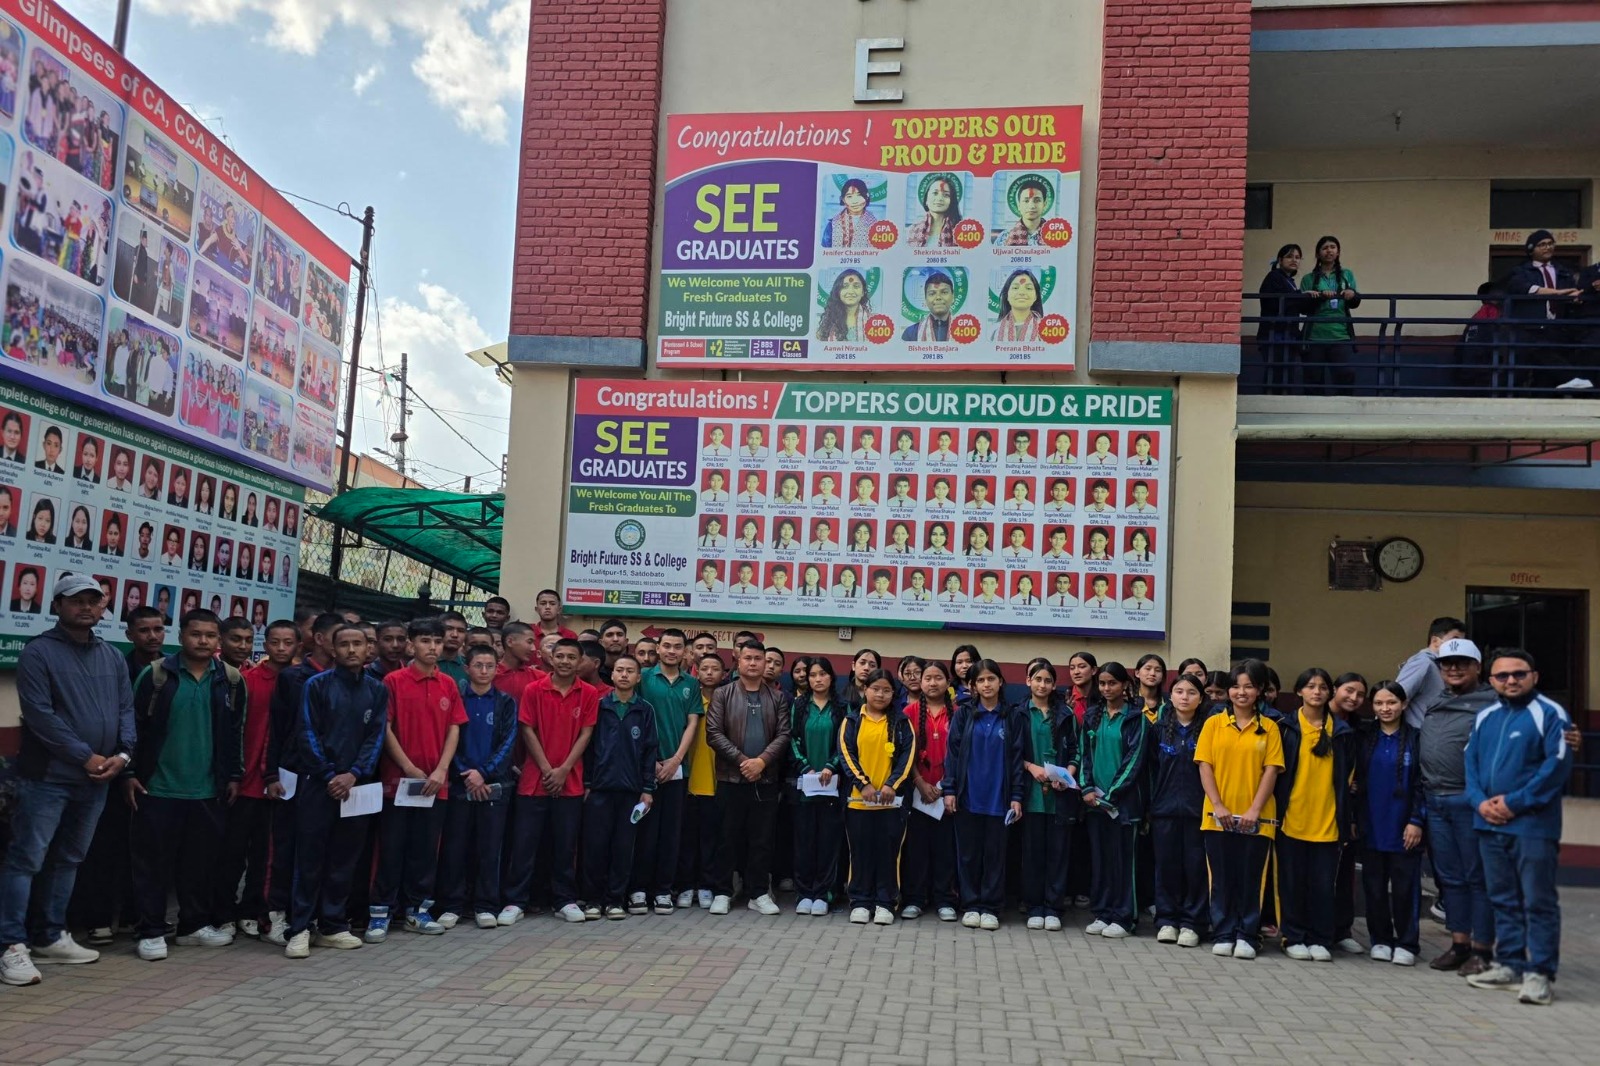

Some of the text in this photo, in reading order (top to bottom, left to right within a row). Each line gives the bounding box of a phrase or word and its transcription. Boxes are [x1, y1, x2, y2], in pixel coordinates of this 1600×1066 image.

[854, 38, 904, 104] E
[19, 0, 115, 79] Glimpses
[121, 74, 140, 97] of
[143, 87, 169, 128] CA,
[174, 114, 206, 156] CCA
[209, 143, 218, 166] &
[222, 153, 248, 191] ECA
[892, 114, 1056, 139] TOPPERS OUR
[677, 118, 872, 156] Congratulations !
[880, 141, 1066, 167] PROUD & PRIDE
[693, 183, 780, 233] SEE
[872, 232, 895, 243] 4:00
[957, 232, 981, 242] 4:00
[1045, 231, 1069, 241] 4:00
[676, 239, 799, 260] GRADUATES
[844, 249, 880, 257] Chaudhary
[668, 277, 804, 288] We Welcome You All The
[683, 292, 787, 303] Fresh Graduates To
[665, 311, 803, 332] Bright Future SS & College
[872, 319, 887, 327] GPA
[867, 327, 891, 337] 4:00
[953, 326, 977, 337] 4:00
[1041, 326, 1066, 337] 4:00
[710, 339, 723, 357] +2
[760, 341, 773, 349] BBS
[783, 341, 801, 351] CA
[597, 386, 769, 411] Congratulations !
[791, 390, 1162, 418] TOPPERS OUR PROUD & PRIDE
[29, 396, 59, 415] college
[60, 405, 69, 417] of
[69, 411, 83, 423] our
[83, 415, 122, 437] generation
[122, 427, 134, 440] has
[134, 434, 150, 446] once
[150, 438, 167, 452] again
[167, 443, 190, 460] created
[193, 453, 215, 469] glorious
[594, 420, 670, 455] SEE
[579, 458, 688, 480] GRADUATES
[576, 489, 691, 502] We Welcome You All The
[589, 502, 677, 514] Fresh Graduates To
[571, 549, 597, 567] Bright
[599, 550, 628, 566] Future
[630, 551, 642, 566] SS
[644, 552, 652, 566] &
[654, 553, 687, 571] College
[630, 570, 665, 578] Satdobato
[608, 590, 619, 604] +2
[669, 593, 685, 602] CA
